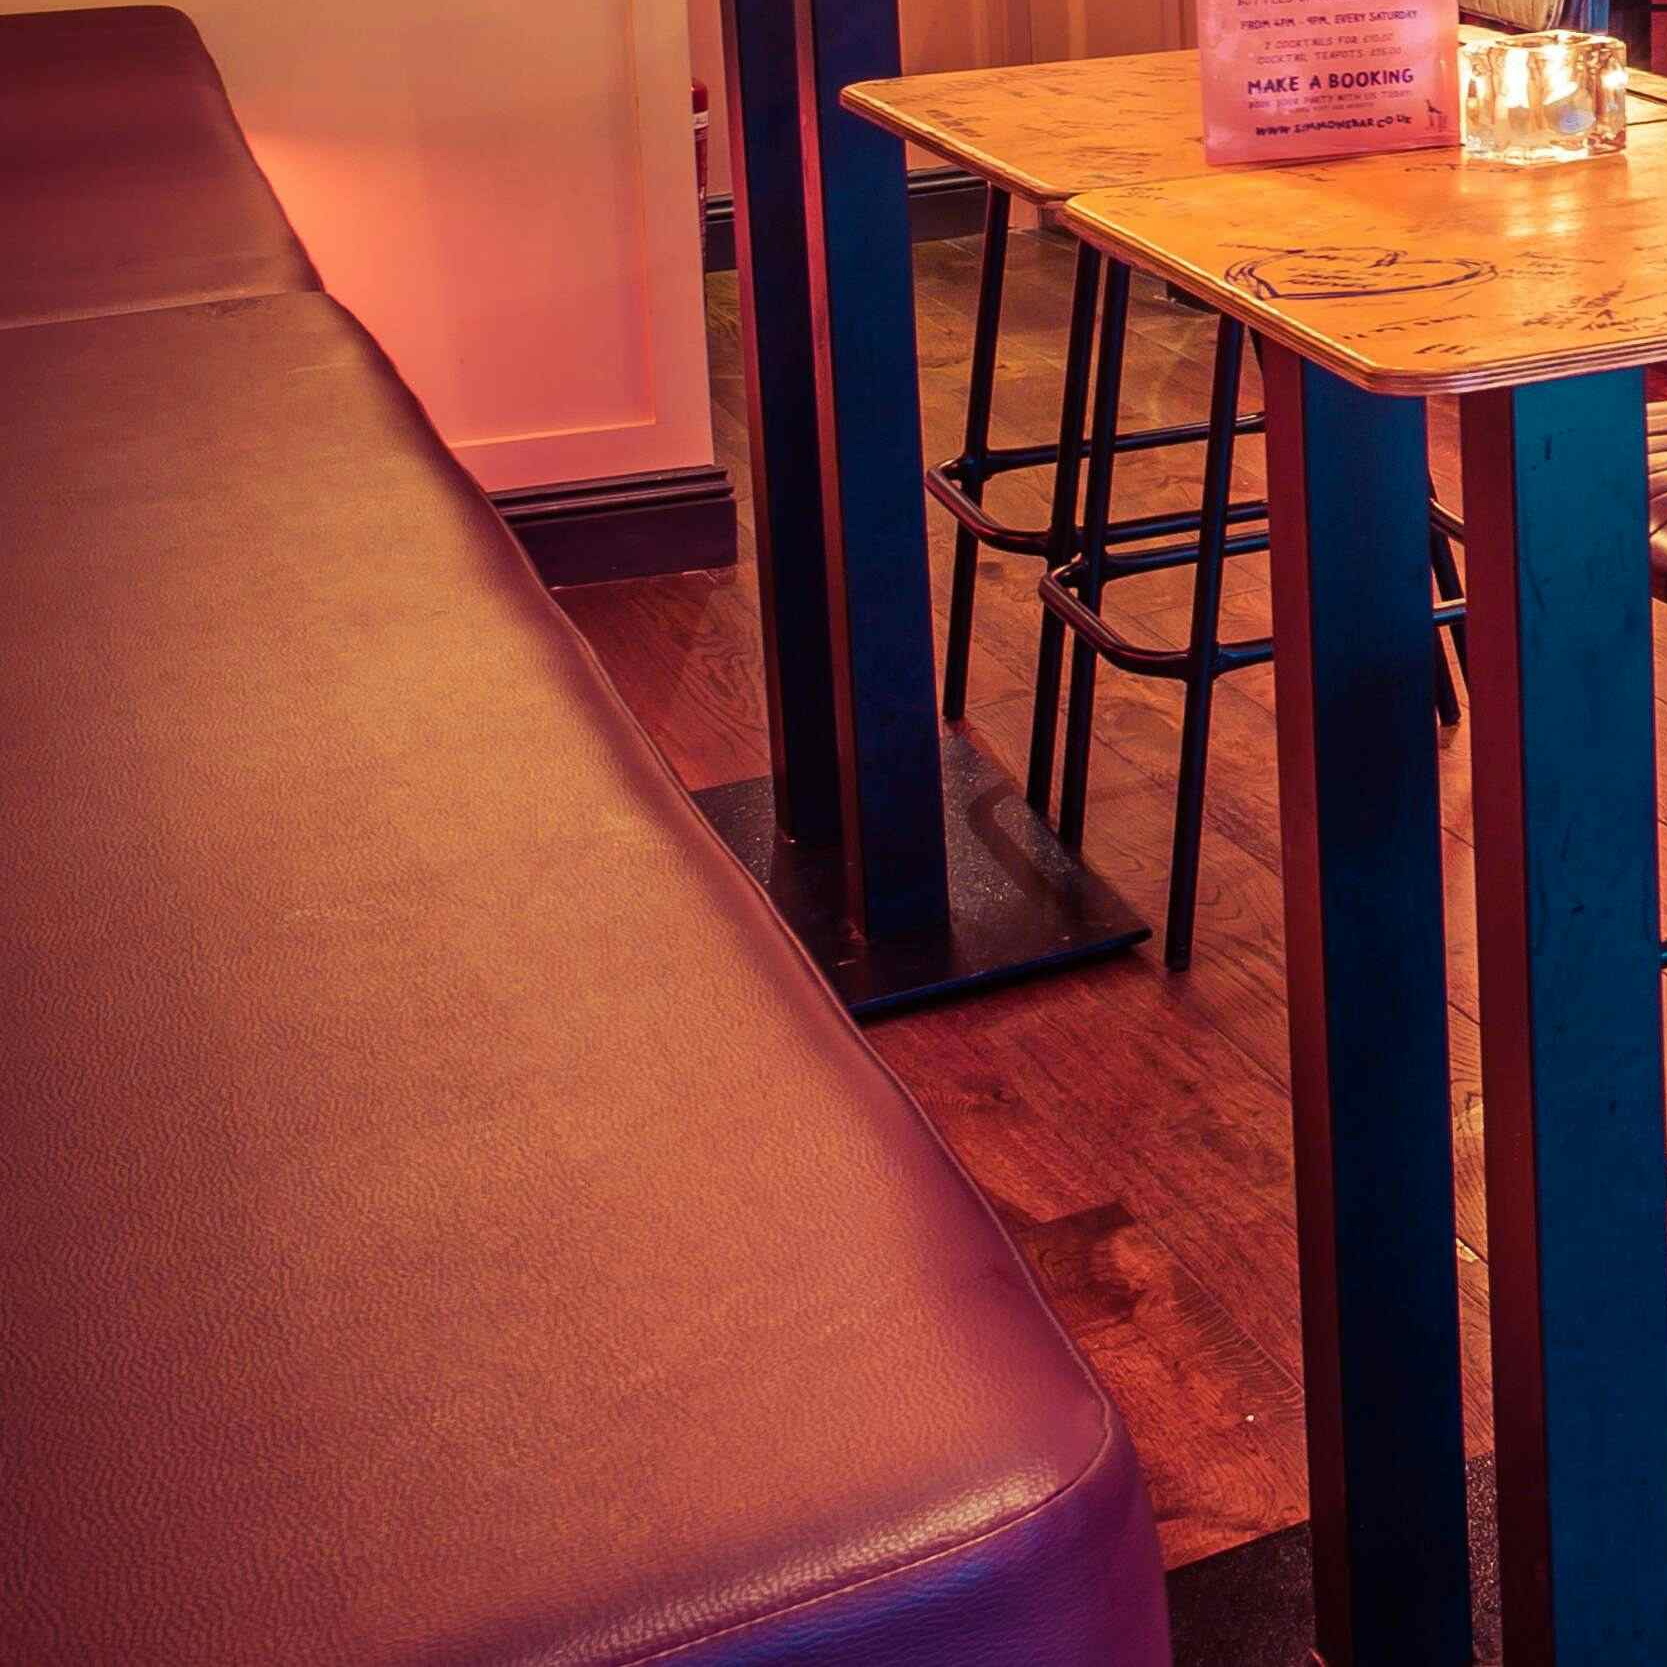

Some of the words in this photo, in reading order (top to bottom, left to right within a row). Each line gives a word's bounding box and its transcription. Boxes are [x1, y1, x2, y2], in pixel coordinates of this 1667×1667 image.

[1240, 20, 1271, 30] FROM
[1335, 13, 1366, 24] EVERY
[1368, 10, 1418, 22] SATURDAY
[1248, 76, 1299, 95] MAKE
[1309, 75, 1321, 90] A
[1328, 68, 1414, 88] BOOKING
